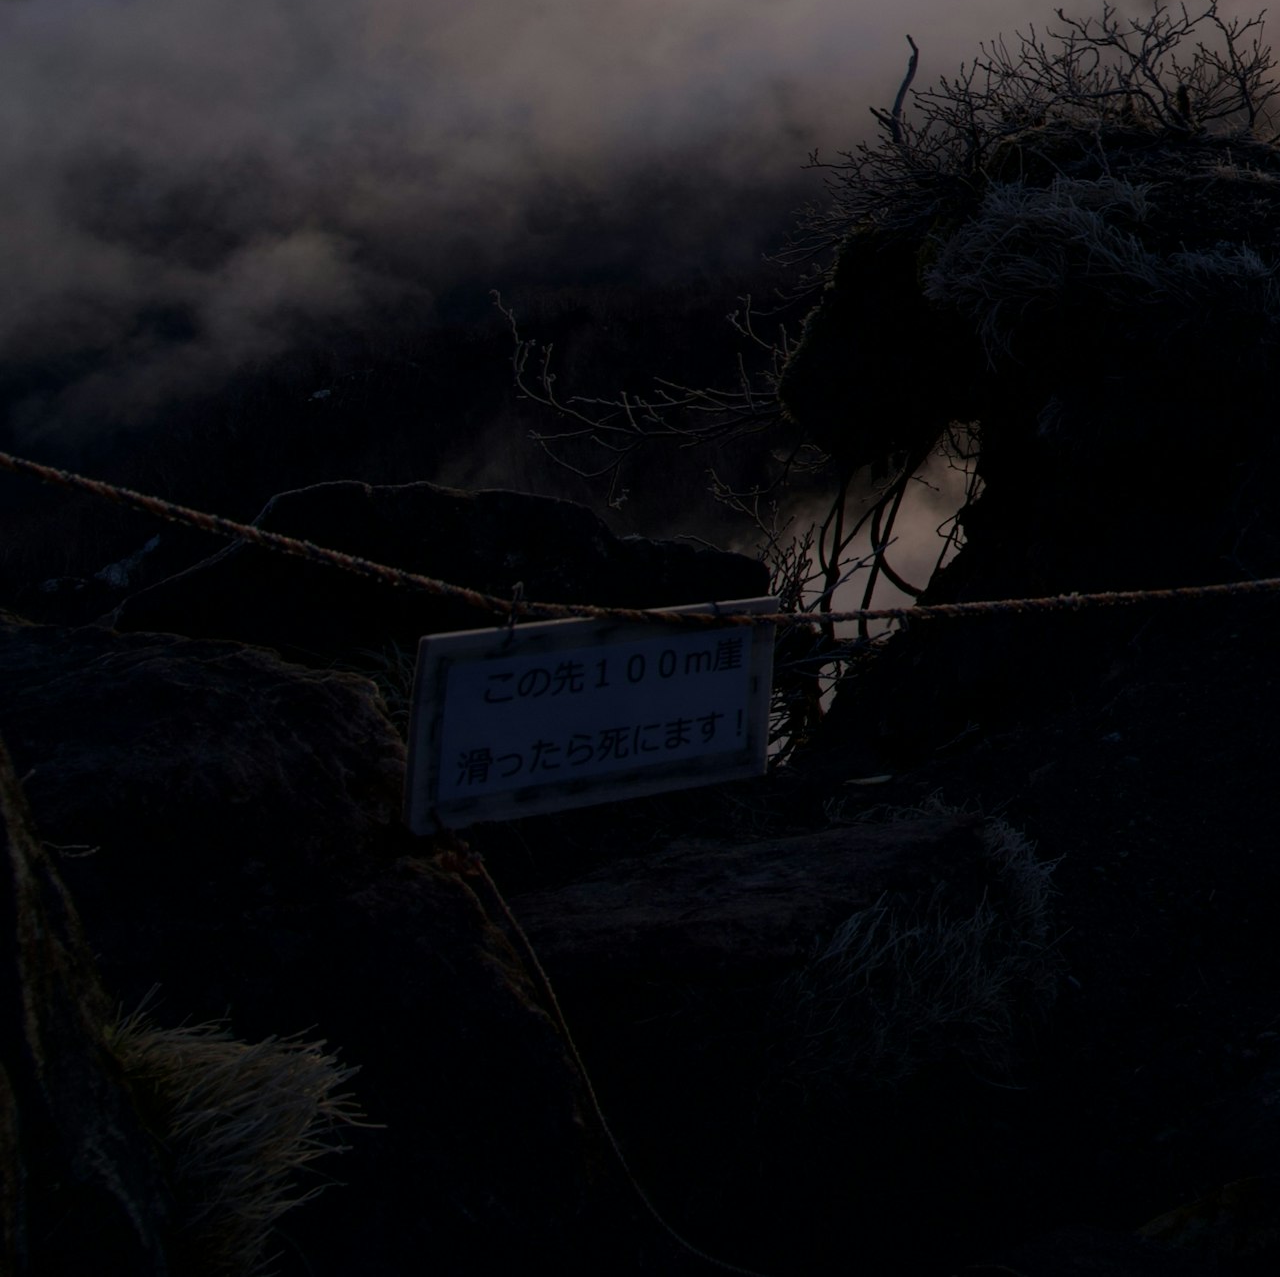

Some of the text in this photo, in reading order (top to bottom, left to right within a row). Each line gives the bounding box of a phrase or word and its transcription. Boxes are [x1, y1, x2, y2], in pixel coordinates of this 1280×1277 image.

[484, 637, 743, 703] この先100m崖
[456, 708, 744, 786] 滑ったら死にます！
